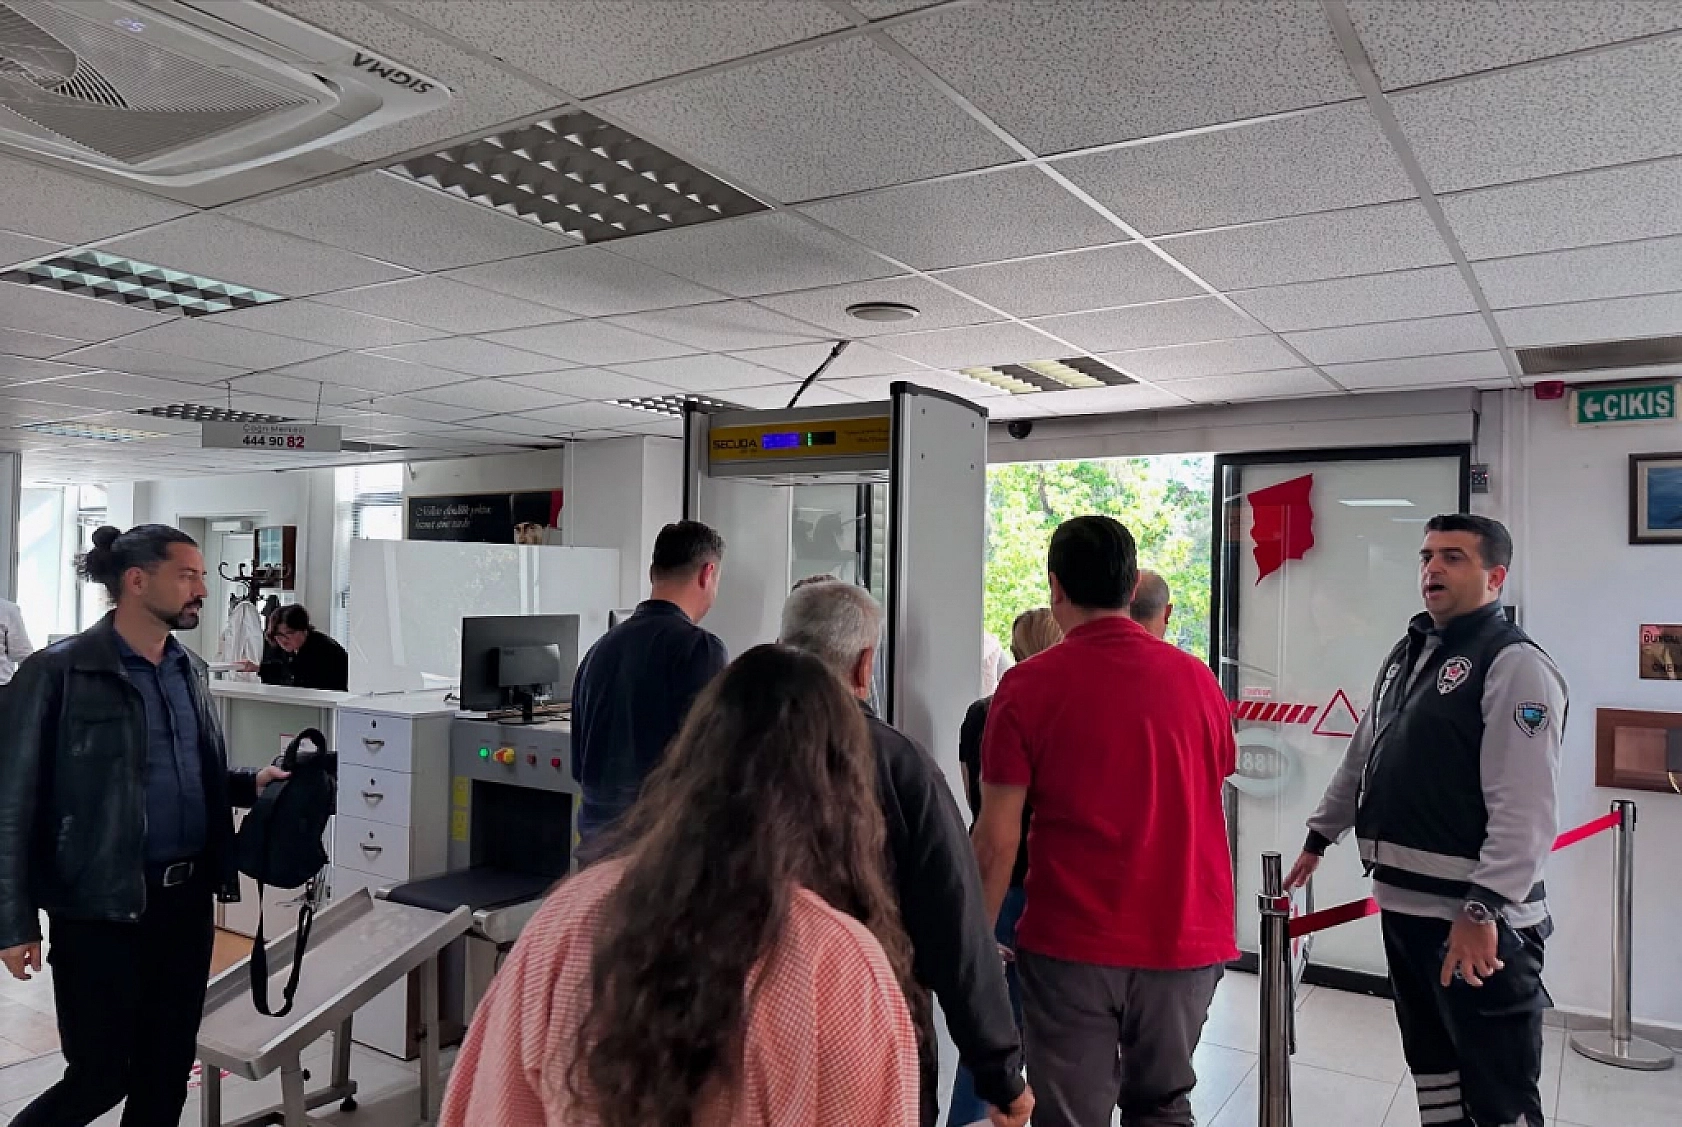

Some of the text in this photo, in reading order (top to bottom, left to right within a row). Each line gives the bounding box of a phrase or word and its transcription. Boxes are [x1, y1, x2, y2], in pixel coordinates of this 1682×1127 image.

[353, 52, 434, 94] SIGMA
[243, 434, 305, 449] 444 90 82
